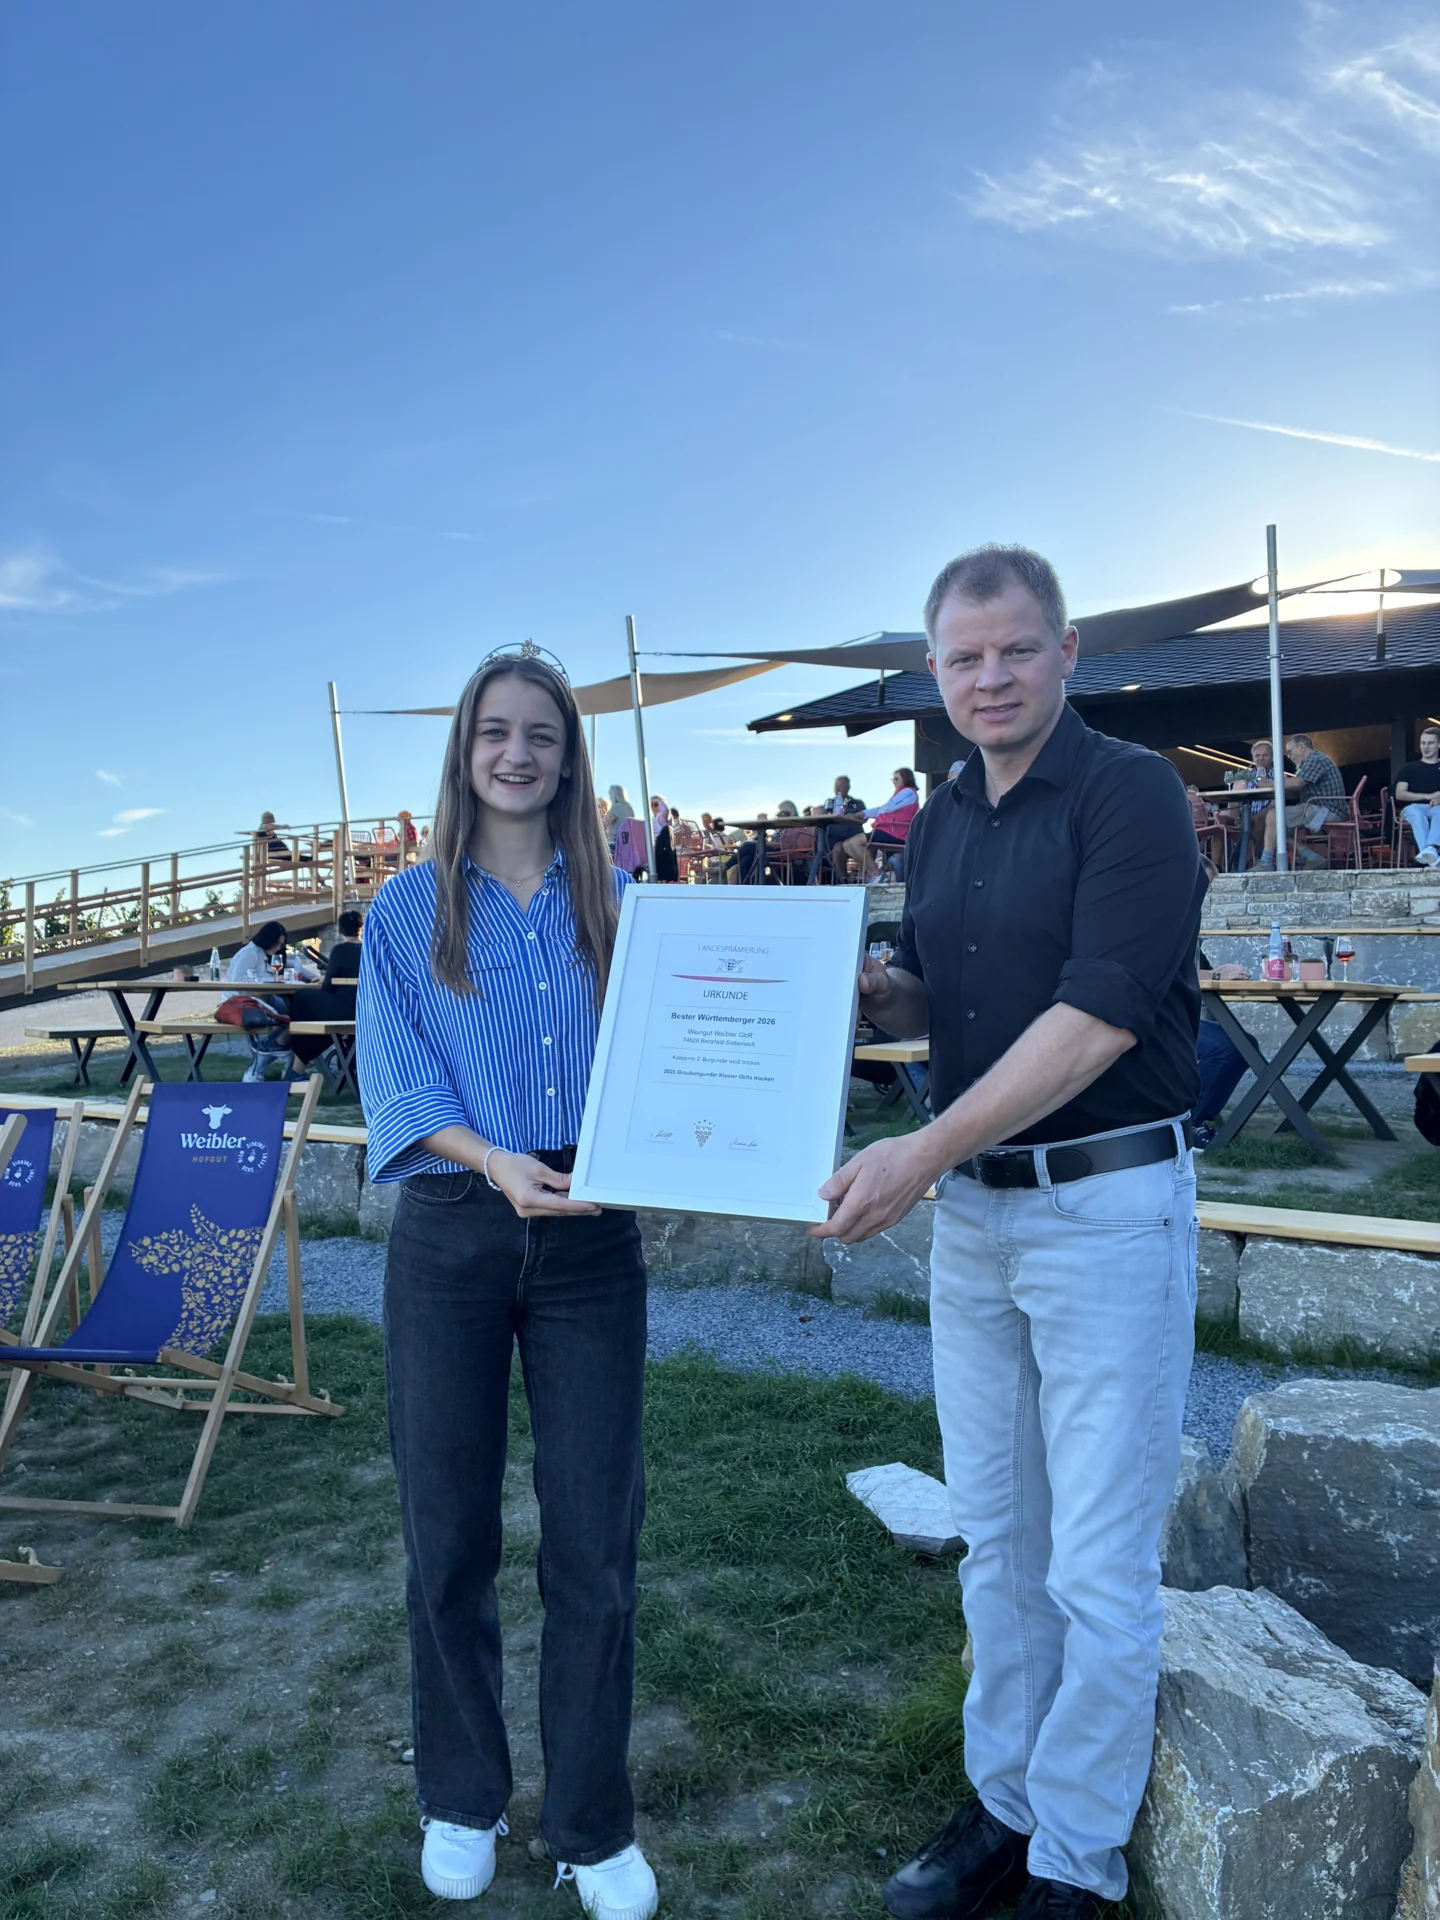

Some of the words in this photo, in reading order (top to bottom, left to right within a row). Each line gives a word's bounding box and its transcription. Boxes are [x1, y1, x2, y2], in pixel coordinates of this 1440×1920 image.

[698, 944, 770, 955] LANDESPRÄMIERUNG
[703, 989, 749, 1001] URKUNDE
[670, 1012, 696, 1021] Bester
[697, 1013, 755, 1025] Württemberger
[757, 1017, 776, 1026] 2026
[687, 1028, 713, 1037] Weingut
[714, 1030, 737, 1038] Weibler
[180, 1132, 247, 1149] Weibler
[192, 1155, 228, 1163] HOFGUT
